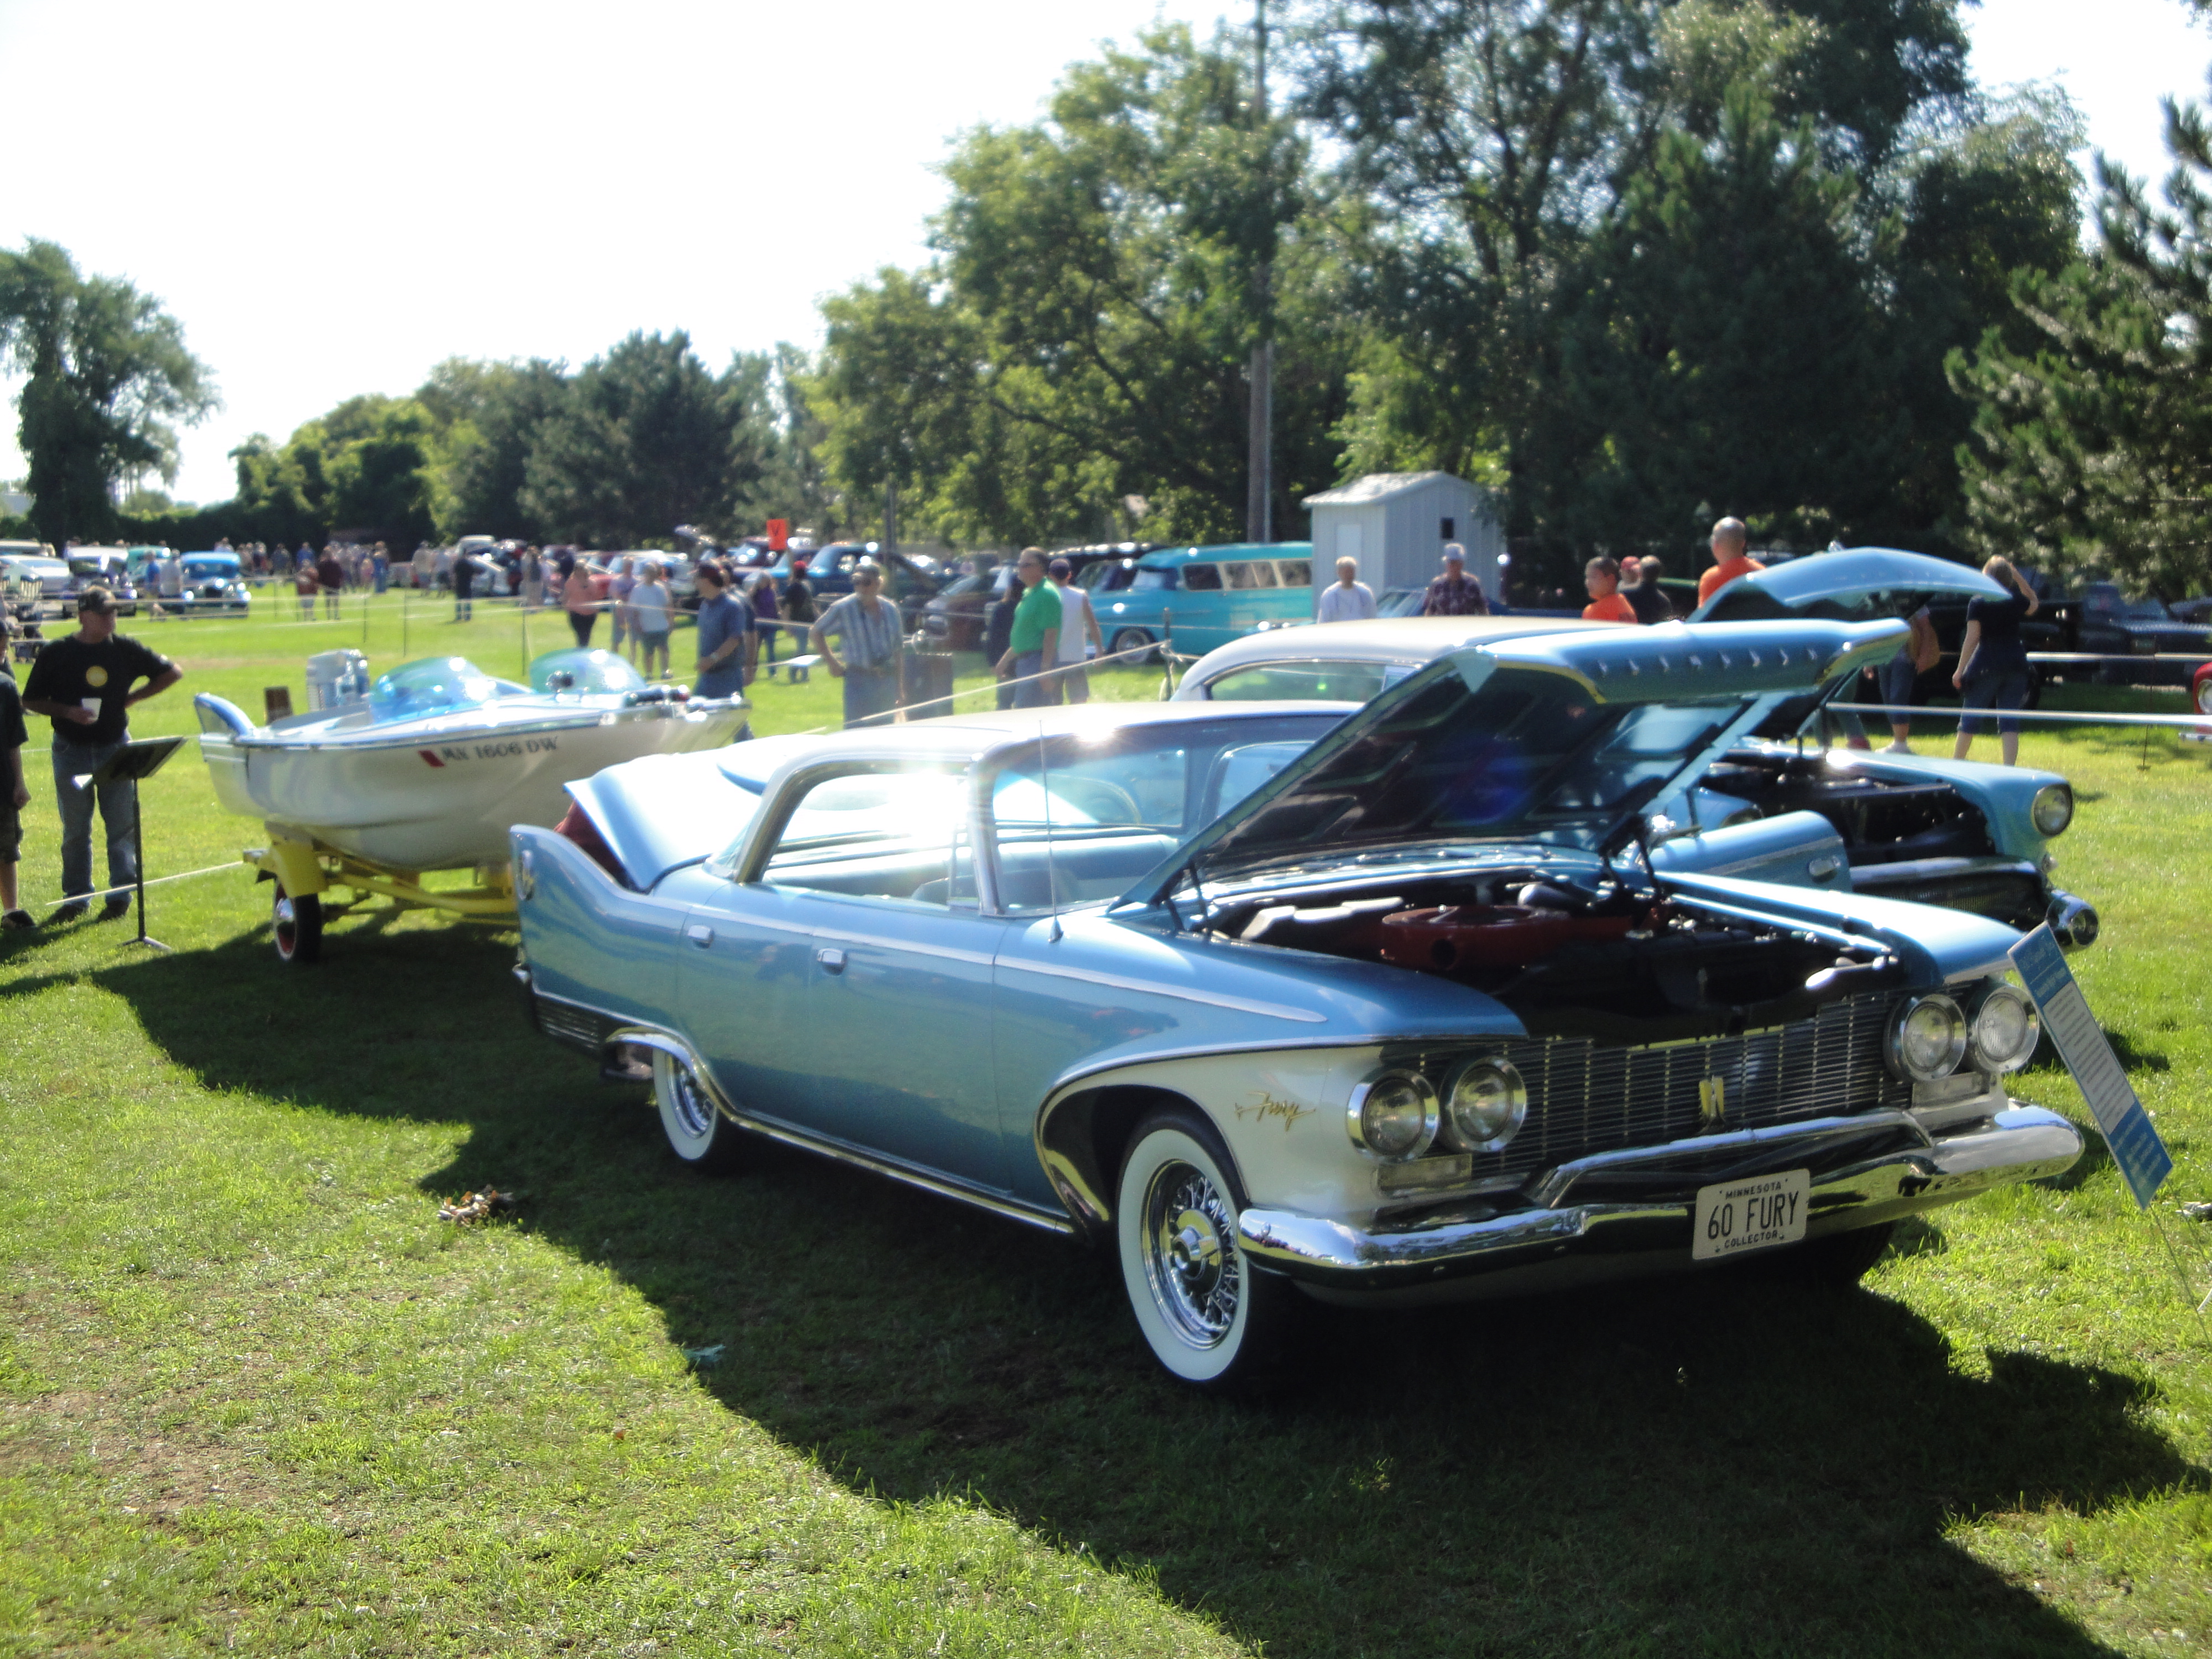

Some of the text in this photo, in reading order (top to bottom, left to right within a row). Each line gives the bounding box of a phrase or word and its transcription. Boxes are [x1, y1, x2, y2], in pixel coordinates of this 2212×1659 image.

[1726, 1182, 1781, 1199] MINNESOTA
[1708, 1191, 1798, 1239] 60 FURY
[1725, 1230, 1777, 1248] COLLECTOR
